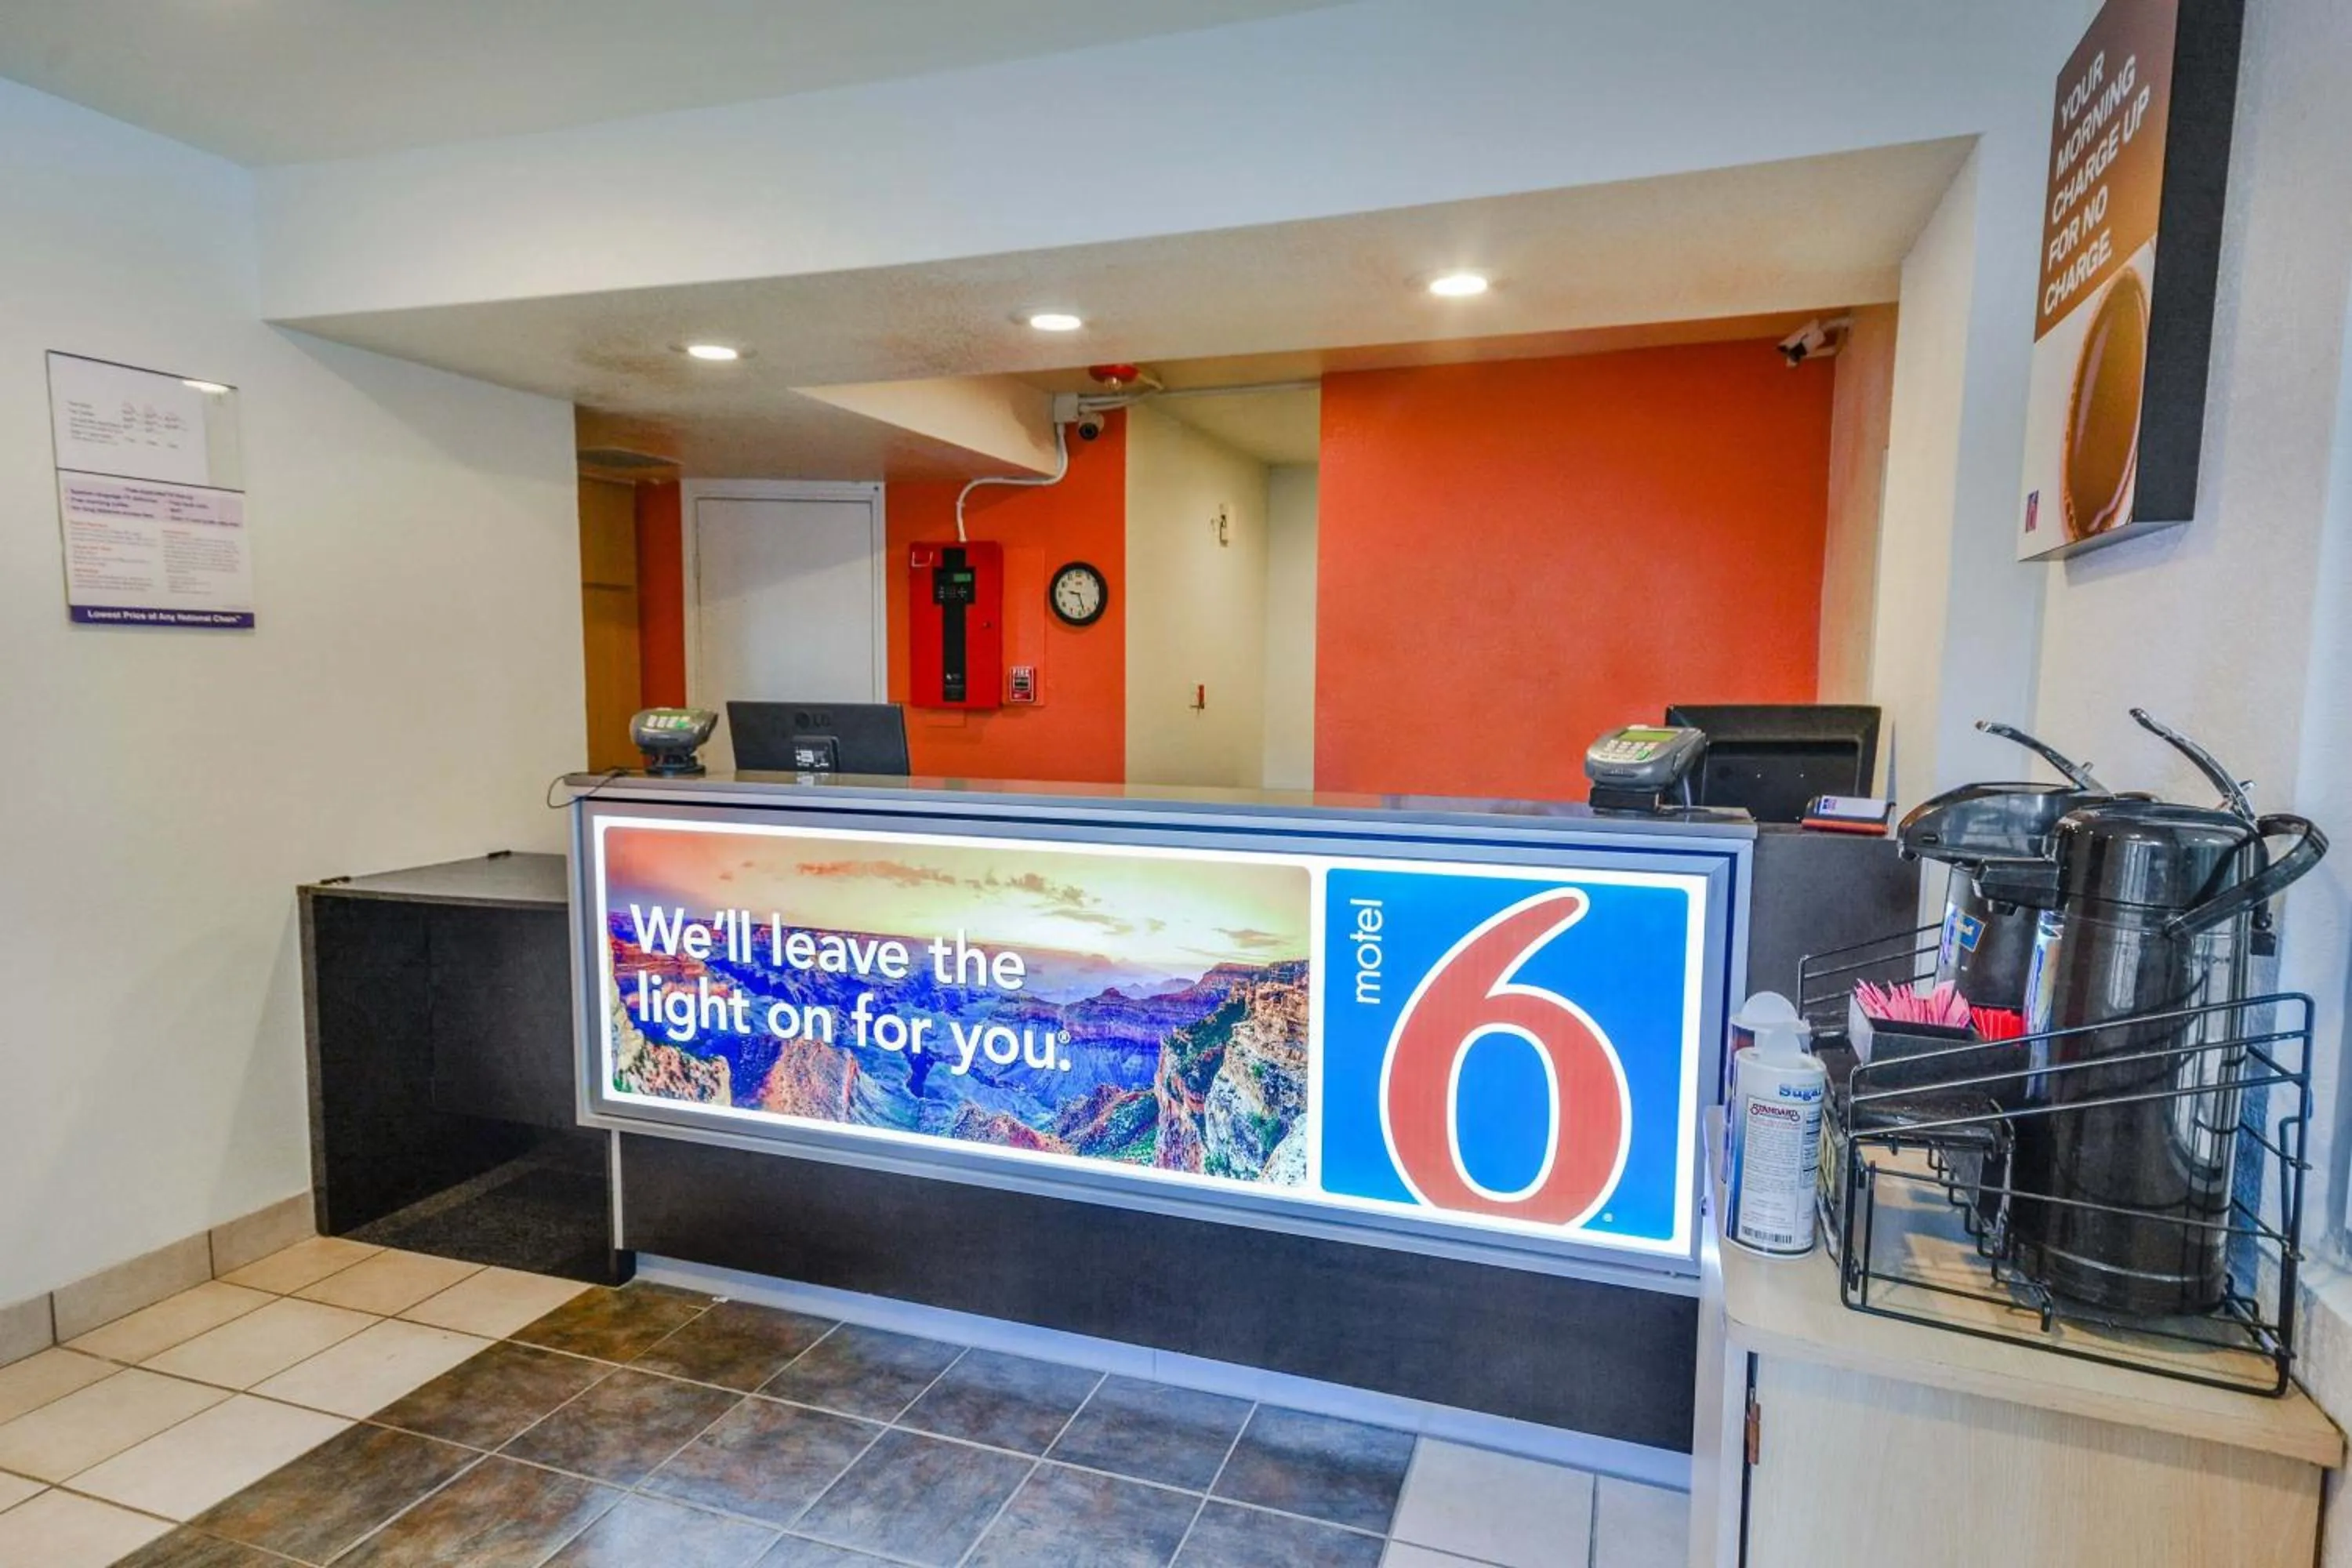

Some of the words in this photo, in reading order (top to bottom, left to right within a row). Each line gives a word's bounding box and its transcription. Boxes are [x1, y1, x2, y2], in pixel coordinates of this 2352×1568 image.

[2056, 54, 2136, 180] MORNING
[2061, 51, 2105, 130] YOUR
[2052, 121, 2121, 224] CHARGE
[2123, 83, 2151, 144] UP
[2048, 215, 2080, 273] FOR
[2082, 184, 2108, 238] NO
[123, 611, 146, 619] Price
[771, 913, 909, 979] leave
[927, 929, 1025, 991] the
[1349, 898, 1384, 1005] motel
[637, 970, 751, 1042] light
[767, 1000, 833, 1044] on
[851, 993, 932, 1054] for
[1378, 887, 1632, 1229] 6
